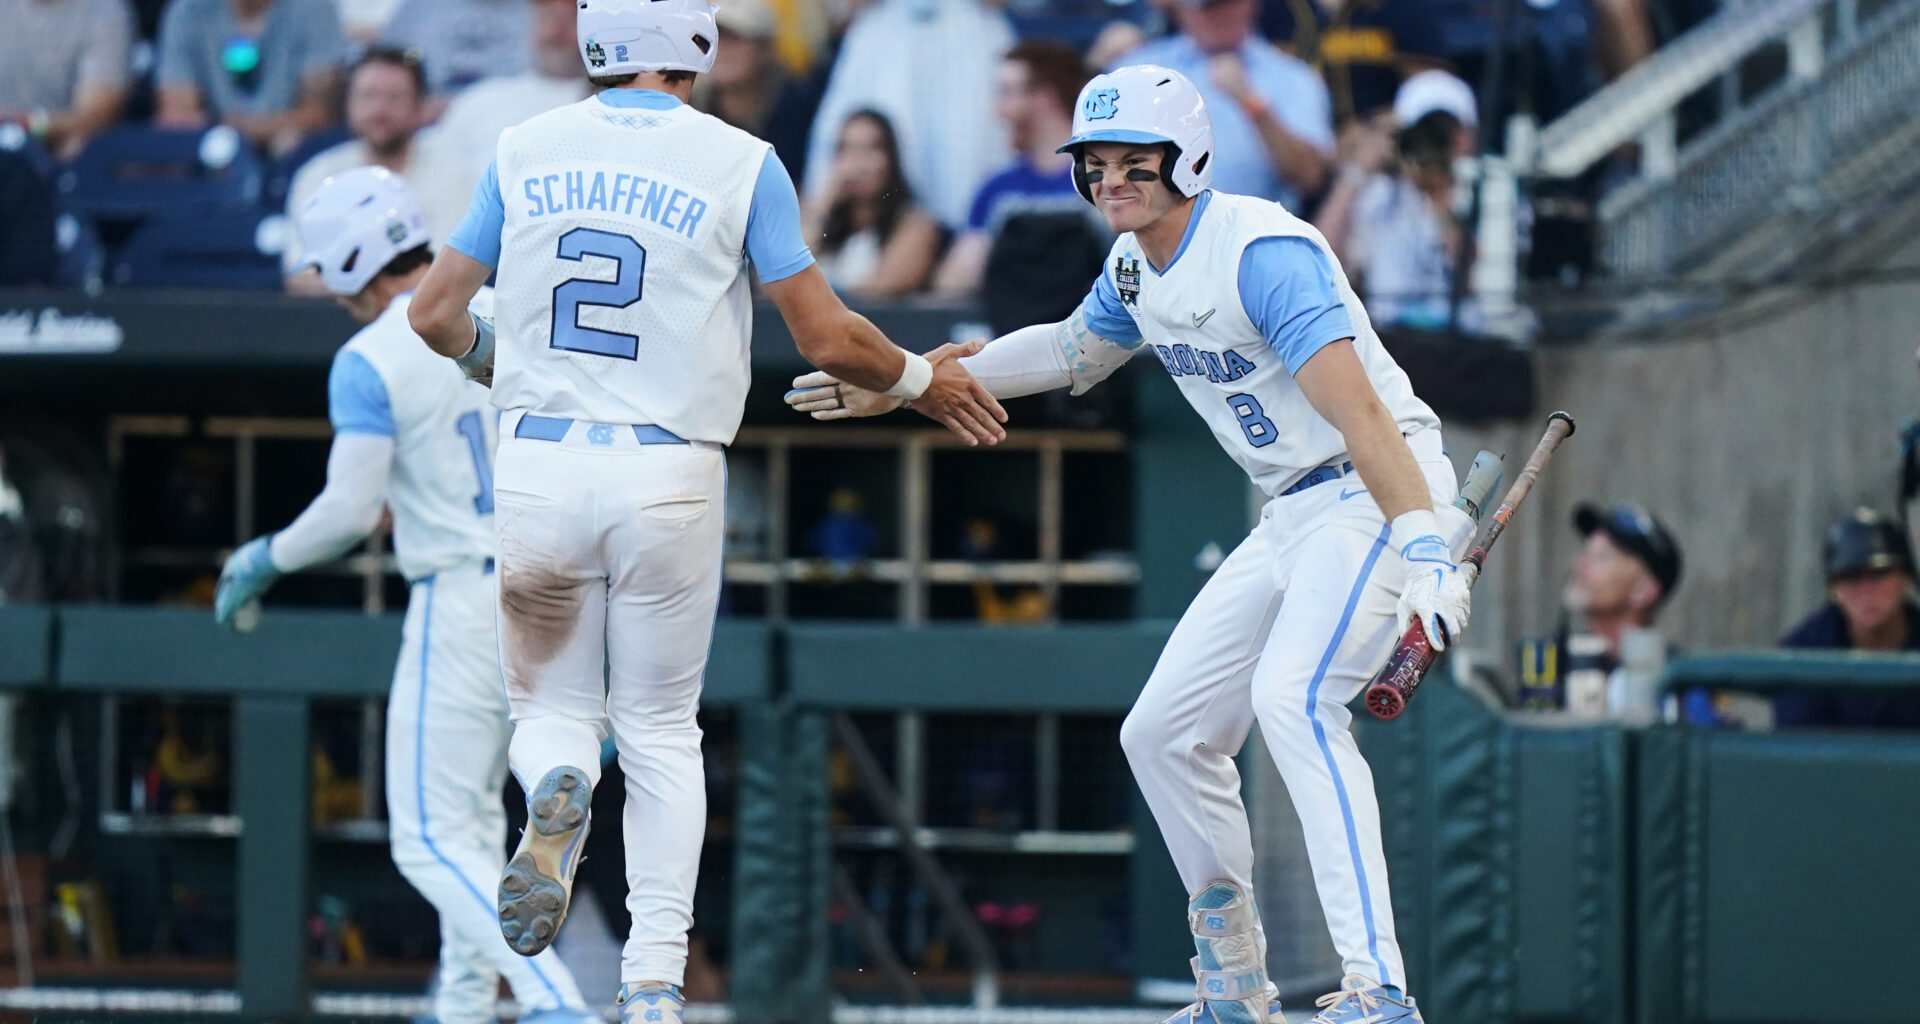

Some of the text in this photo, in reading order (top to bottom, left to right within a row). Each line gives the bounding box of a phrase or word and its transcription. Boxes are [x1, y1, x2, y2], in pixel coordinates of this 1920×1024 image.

[615, 45, 629, 62] 2
[524, 170, 707, 239] SCHAFFNER
[549, 226, 647, 361] 2
[1225, 392, 1279, 448] 8
